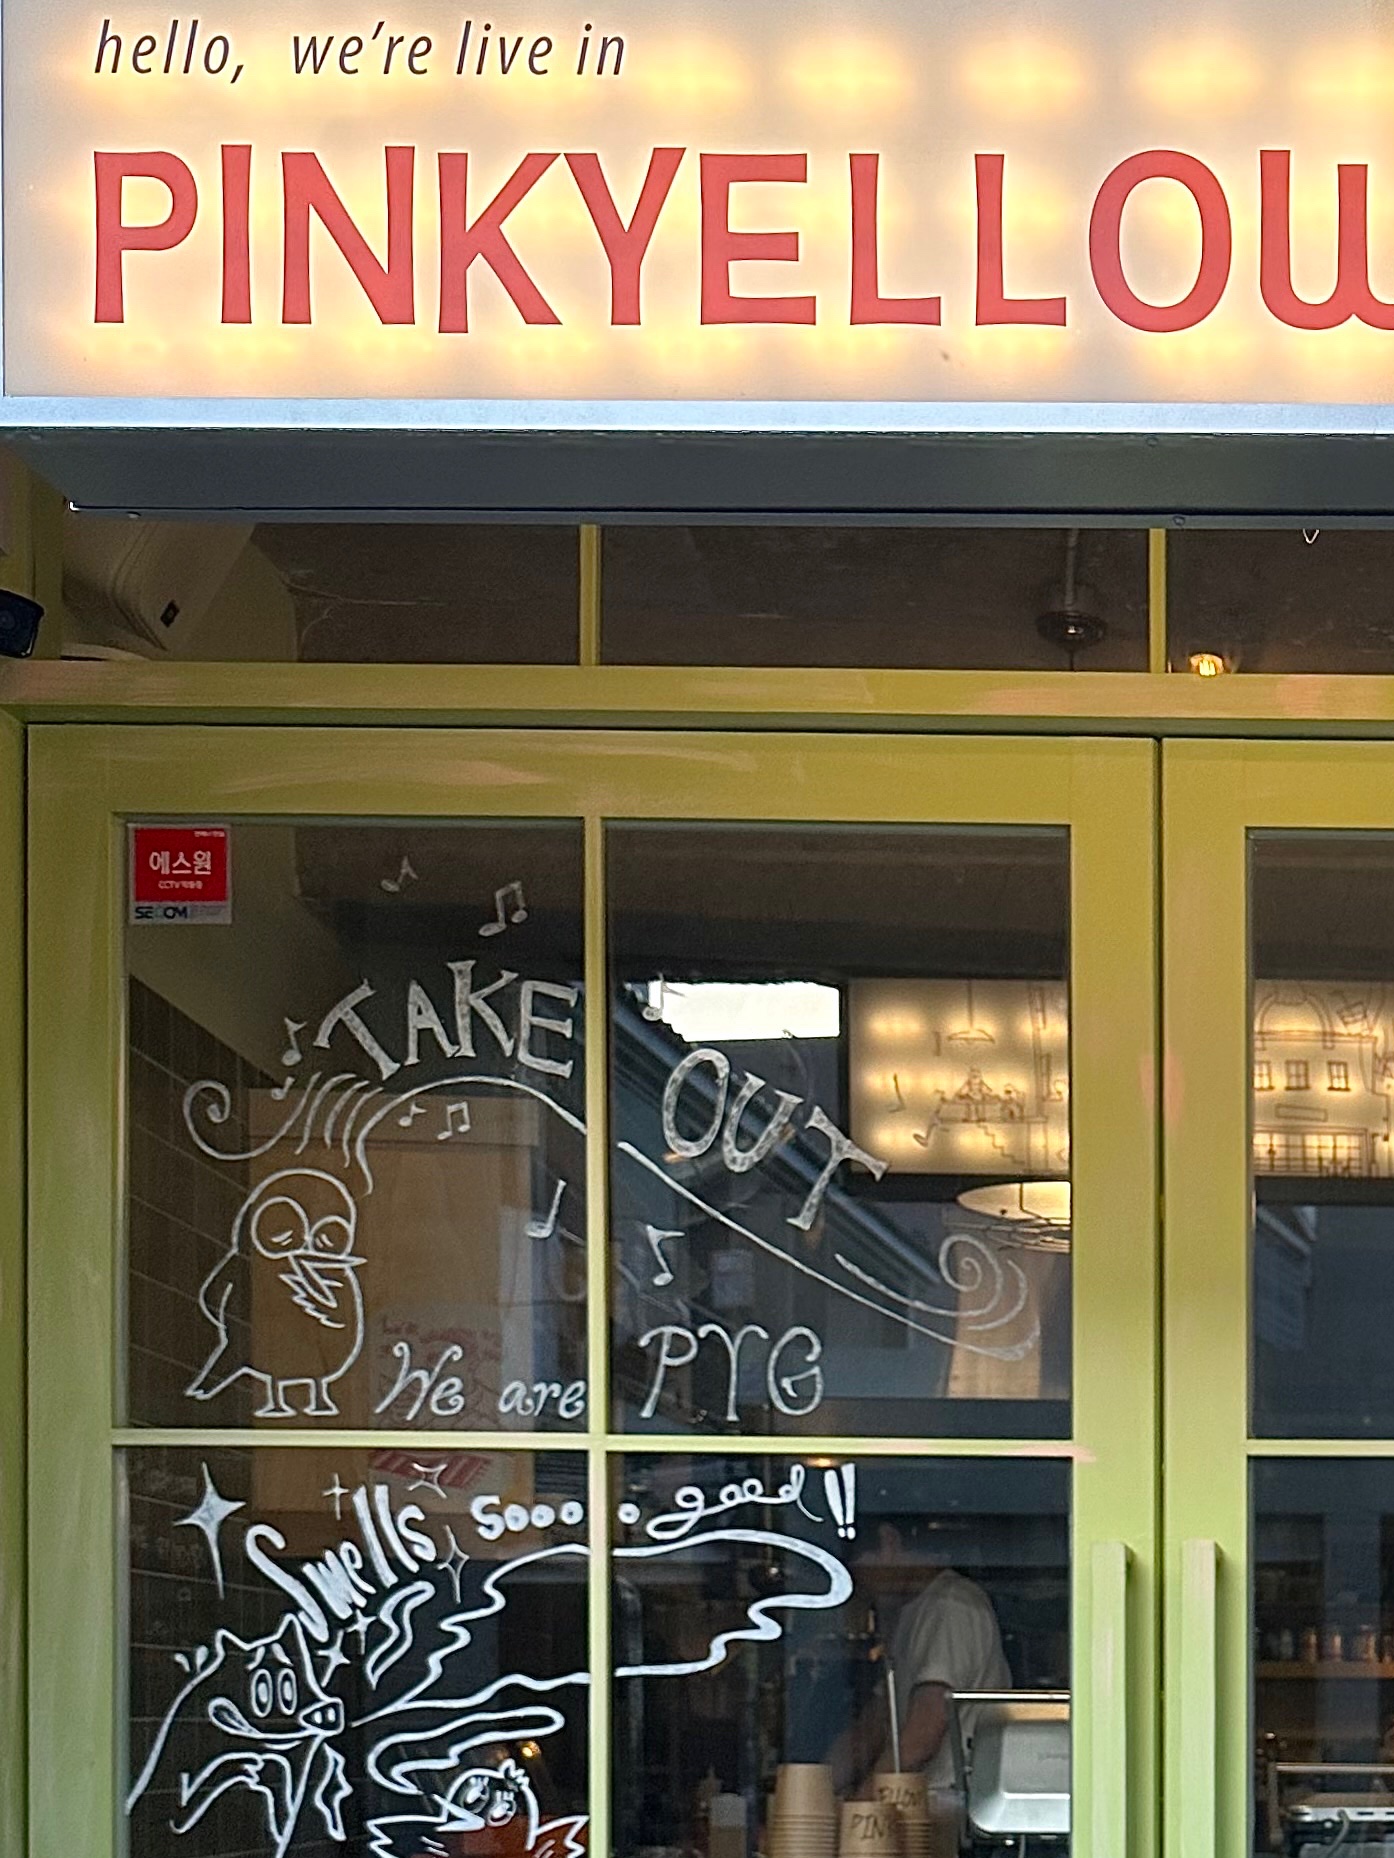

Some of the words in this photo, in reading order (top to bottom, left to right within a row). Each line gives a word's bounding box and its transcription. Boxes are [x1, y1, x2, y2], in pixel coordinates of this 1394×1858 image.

[94, 19, 247, 85] hello,
[456, 20, 552, 77] live
[576, 23, 626, 77] in
[148, 850, 212, 875] 에스원
[135, 906, 188, 919] SEOM
[314, 959, 580, 1080] TAKE
[662, 1048, 891, 1231] OUT
[374, 1341, 466, 1421] We
[499, 1379, 587, 1418] are
[246, 1484, 437, 1643] Smells
